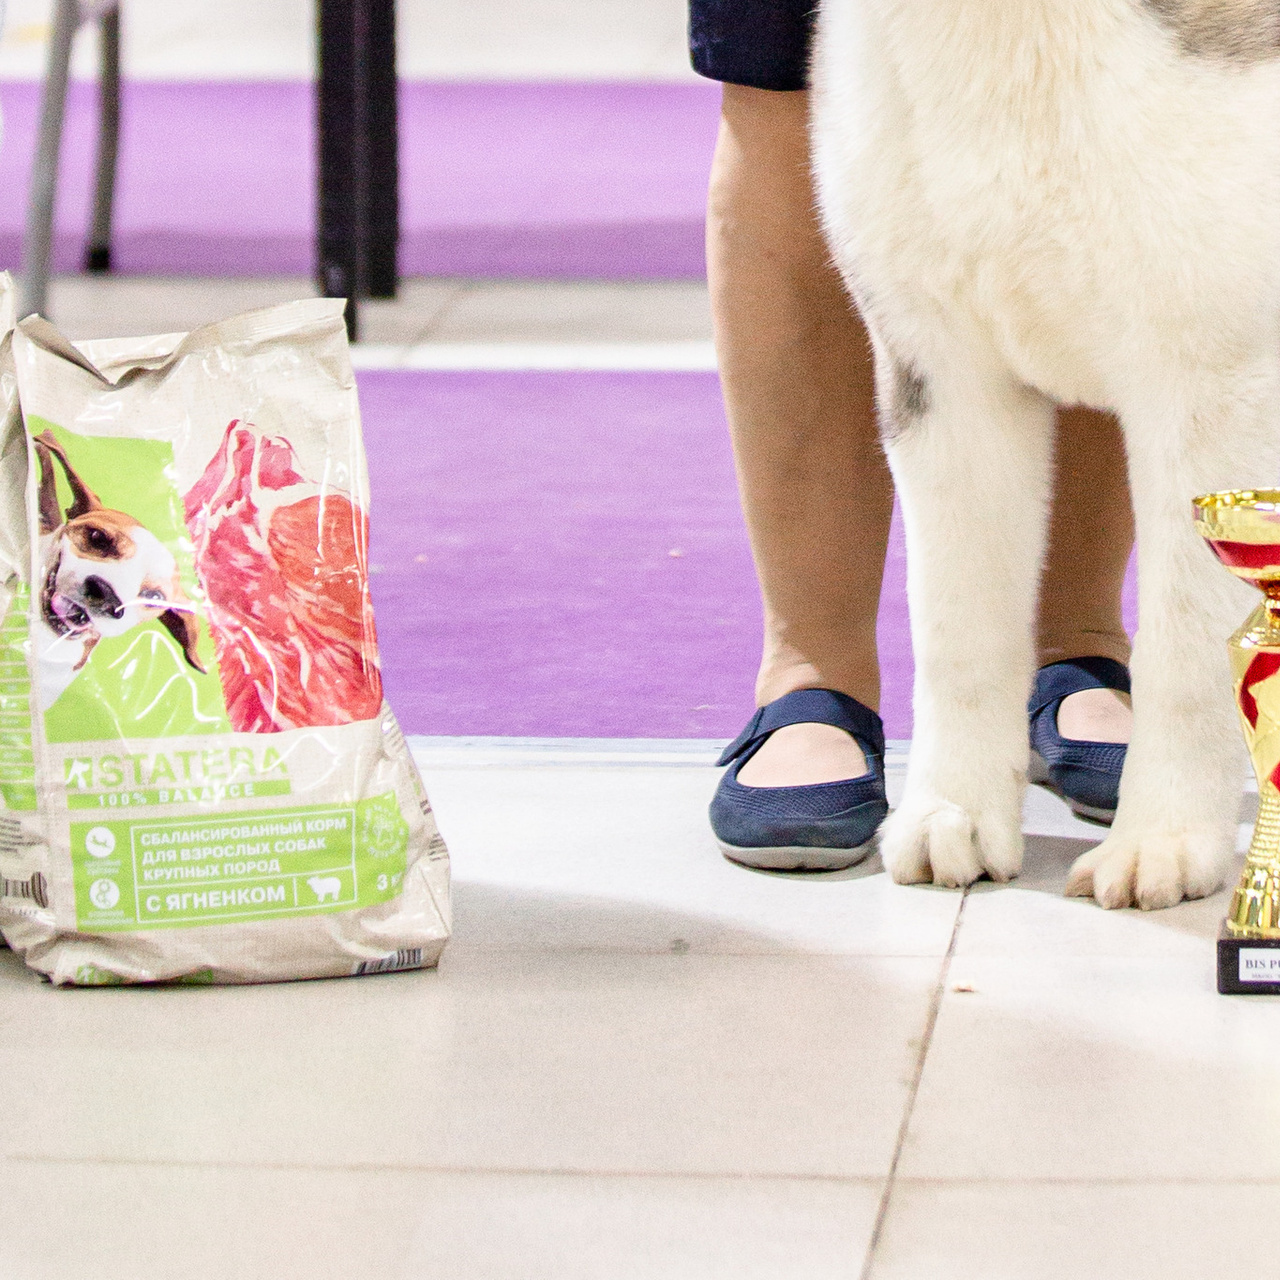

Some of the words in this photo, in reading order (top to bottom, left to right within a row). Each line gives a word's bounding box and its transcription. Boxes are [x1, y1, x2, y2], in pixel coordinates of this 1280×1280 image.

[99, 746, 289, 787] STATERA
[98, 792, 147, 807] 100%
[141, 818, 303, 846] СБАЛАНСИРОВАННЫЙ
[306, 817, 347, 833] КОРМ
[142, 850, 177, 866] ДЛЯ
[180, 841, 270, 861] ВЗРОСЛЫХ
[274, 837, 326, 852] СОБАК
[143, 864, 220, 881] КРУПНЫХ
[223, 859, 281, 875] ПОРОД
[376, 873, 388, 891] 3
[145, 895, 161, 913] С
[165, 885, 286, 911] ЯГНЕНКОМ
[1245, 959, 1266, 969] BIS
